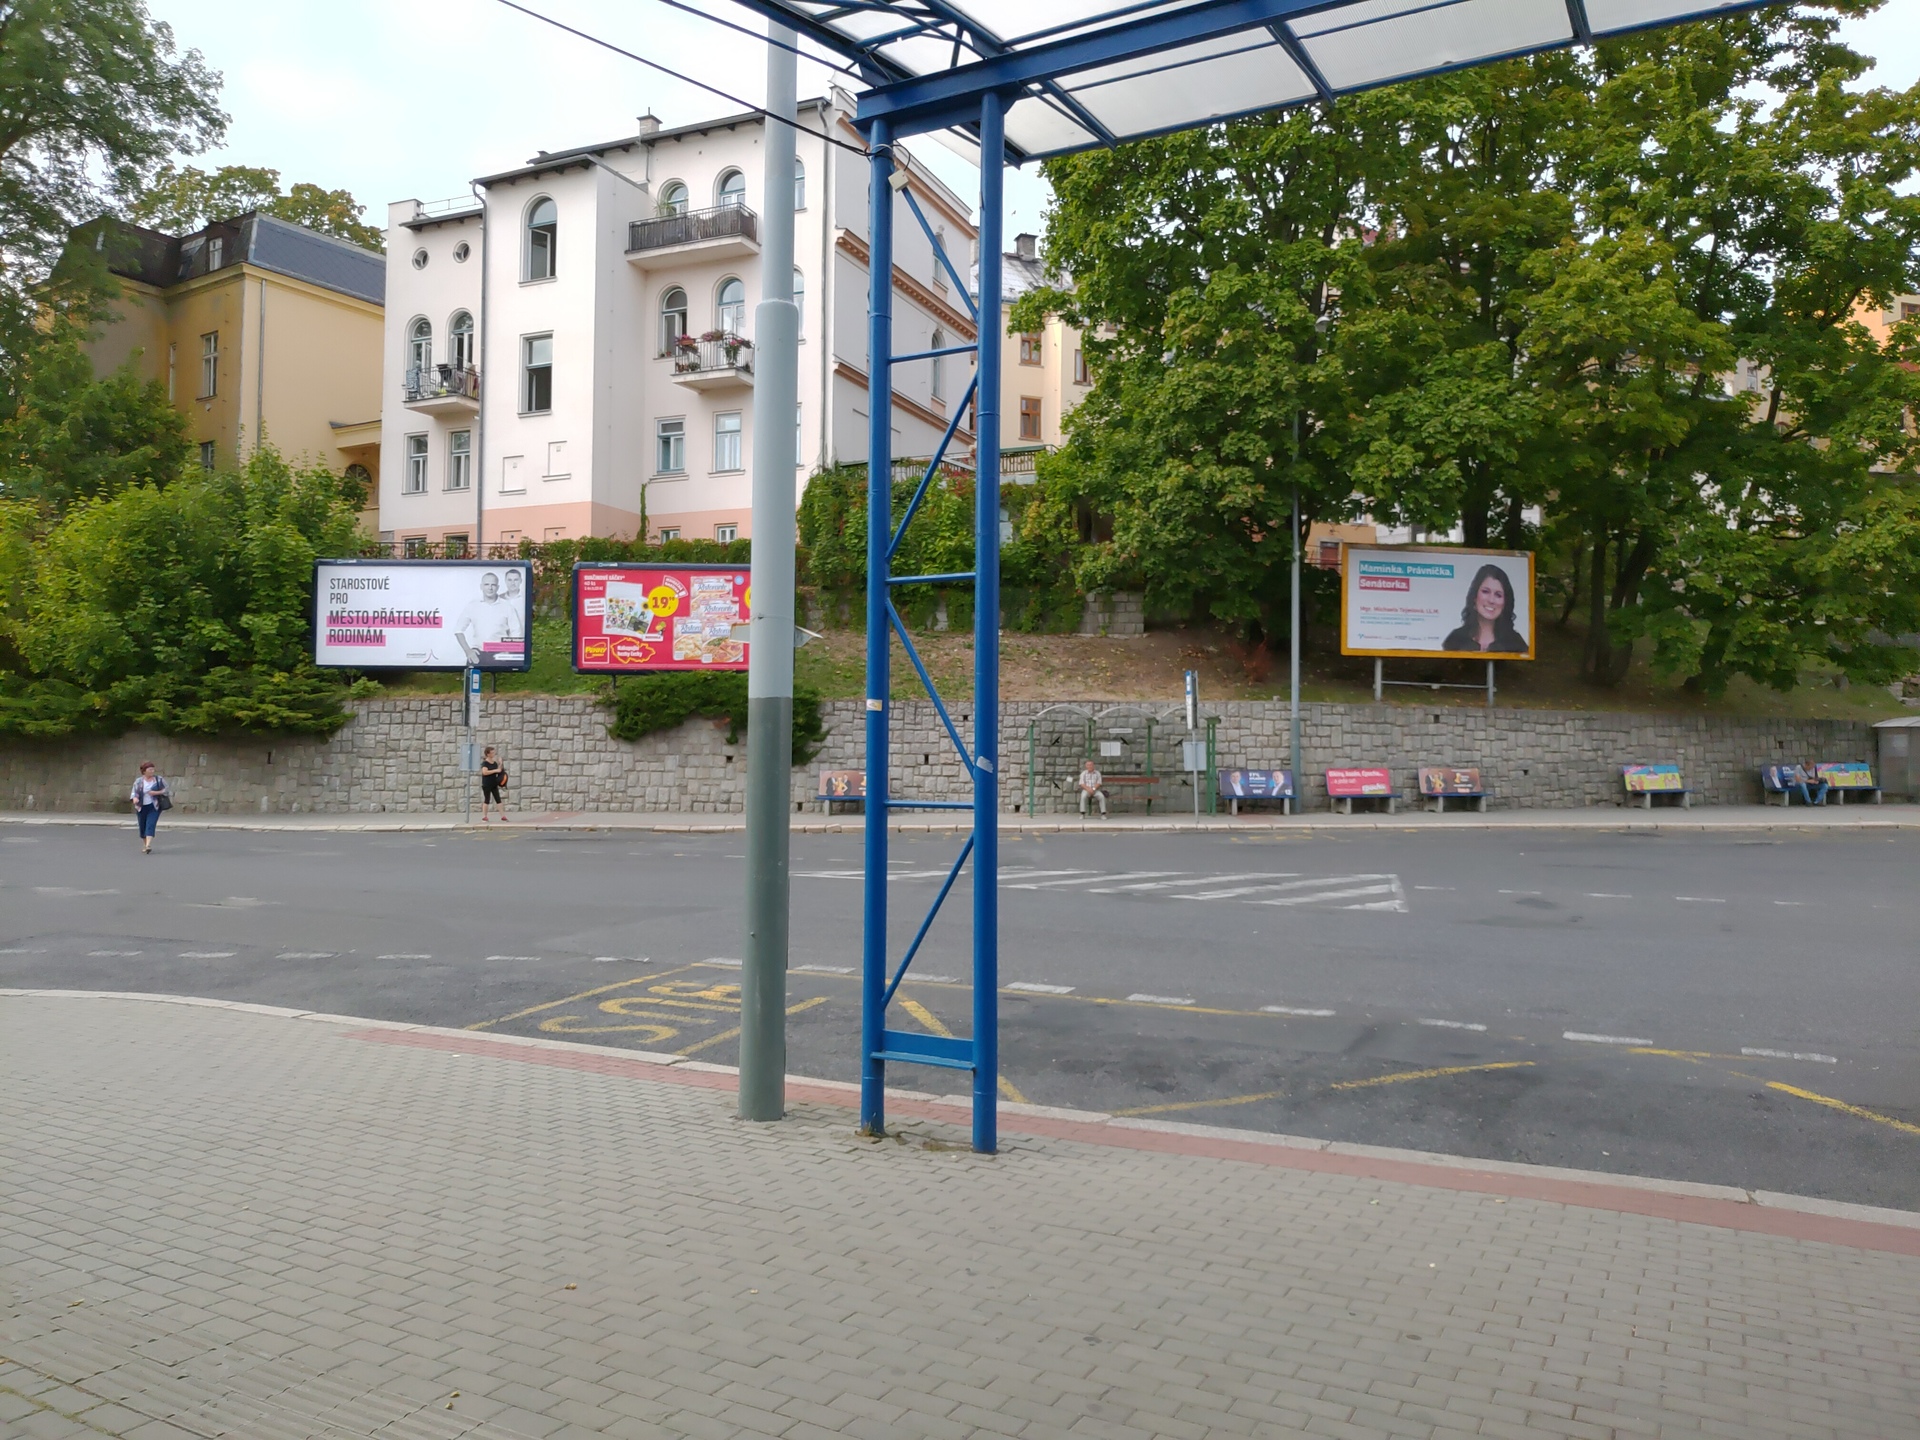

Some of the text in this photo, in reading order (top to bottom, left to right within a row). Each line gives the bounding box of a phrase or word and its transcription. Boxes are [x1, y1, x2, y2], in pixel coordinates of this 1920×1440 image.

[1360, 564, 1453, 576] Maminka. Právnička.
[329, 576, 390, 590] STAROSTOVÉ
[1360, 578, 1408, 589] Senátorka.
[329, 592, 348, 605] PRO
[703, 605, 734, 613] Ristorante
[329, 607, 440, 625] MĚSTO PŘÁTELSKÉ
[328, 626, 383, 644] RODINÁM
